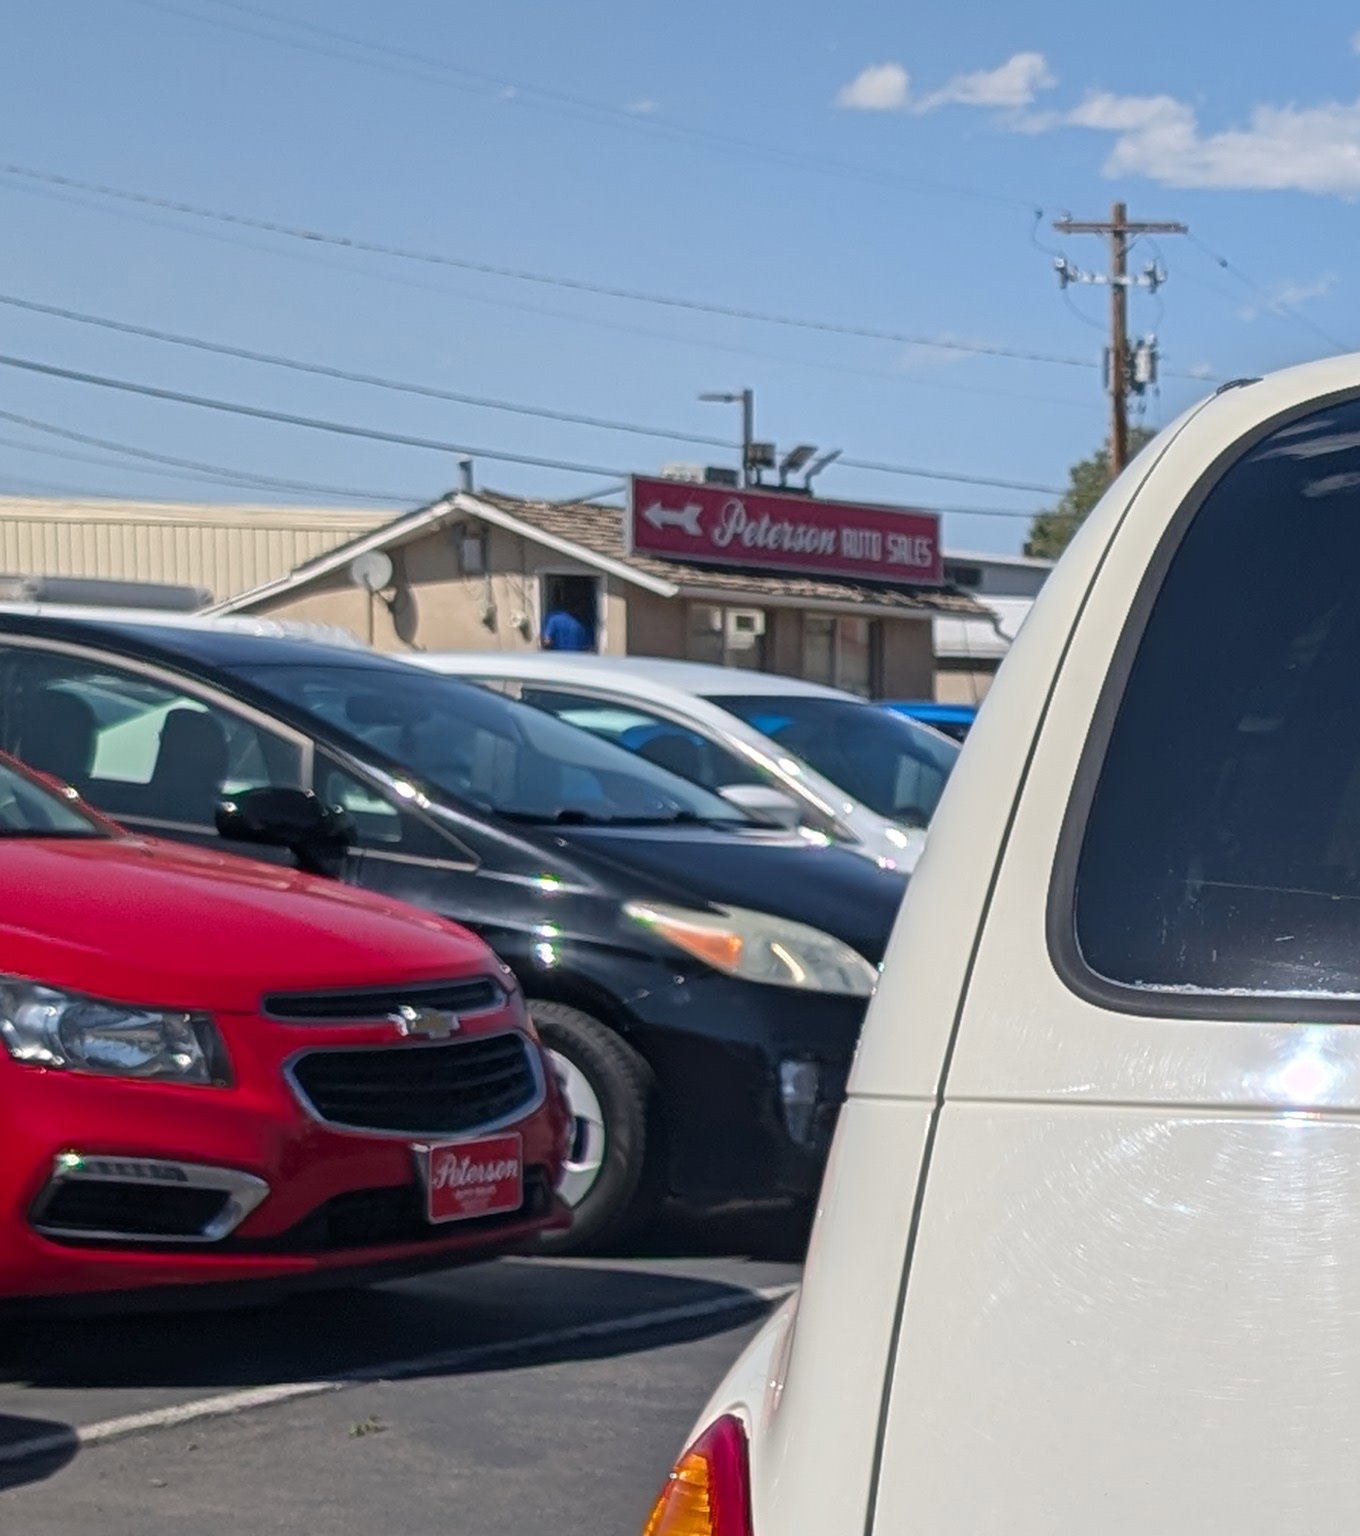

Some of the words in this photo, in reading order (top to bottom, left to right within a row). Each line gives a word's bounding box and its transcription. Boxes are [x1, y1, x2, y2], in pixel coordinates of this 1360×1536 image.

[711, 498, 839, 557] Peterson
[841, 528, 883, 563] AUTO
[887, 533, 934, 569] SALES
